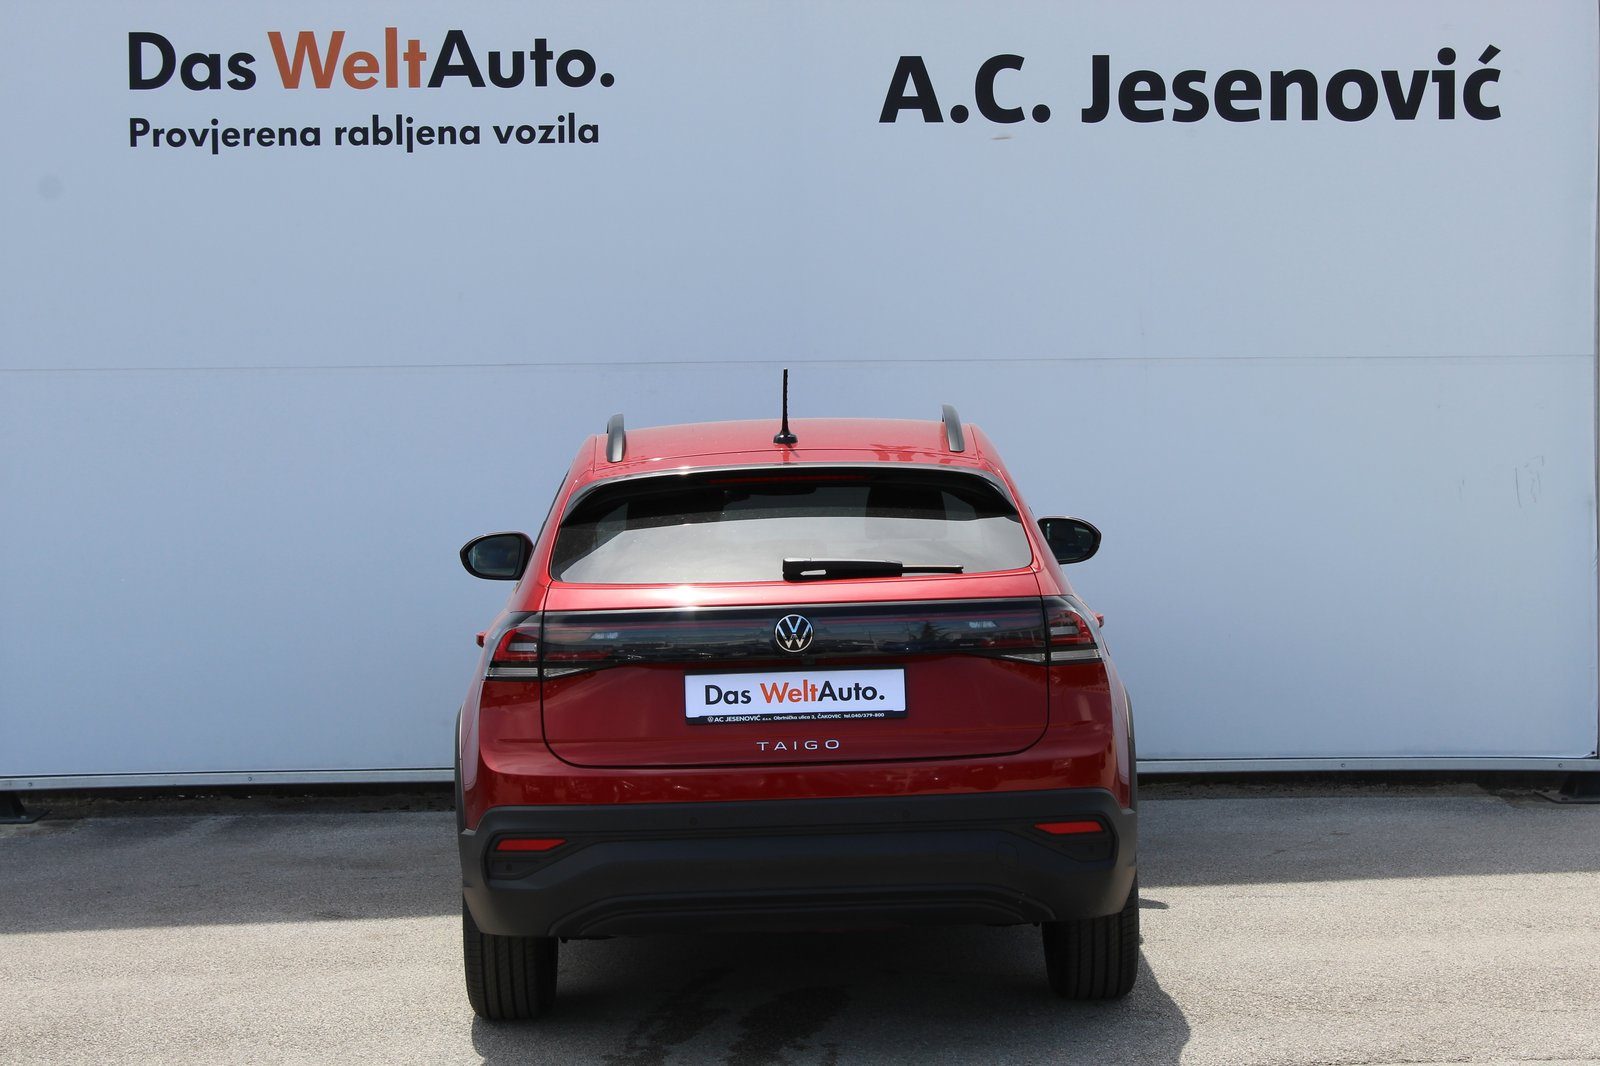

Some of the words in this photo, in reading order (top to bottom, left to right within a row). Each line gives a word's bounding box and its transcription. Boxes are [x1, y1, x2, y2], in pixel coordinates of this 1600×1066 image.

[128, 31, 256, 91] Das
[267, 27, 615, 90] WeltAuto.
[879, 54, 1051, 124] A.C.
[1082, 44, 1502, 123] Jesenović
[129, 118, 321, 155] Provjerena
[335, 114, 481, 153] rabljena
[493, 112, 599, 145] vozila
[705, 684, 751, 705] Das
[760, 679, 885, 703] WeltAuto.
[756, 739, 840, 751] TAIGO
